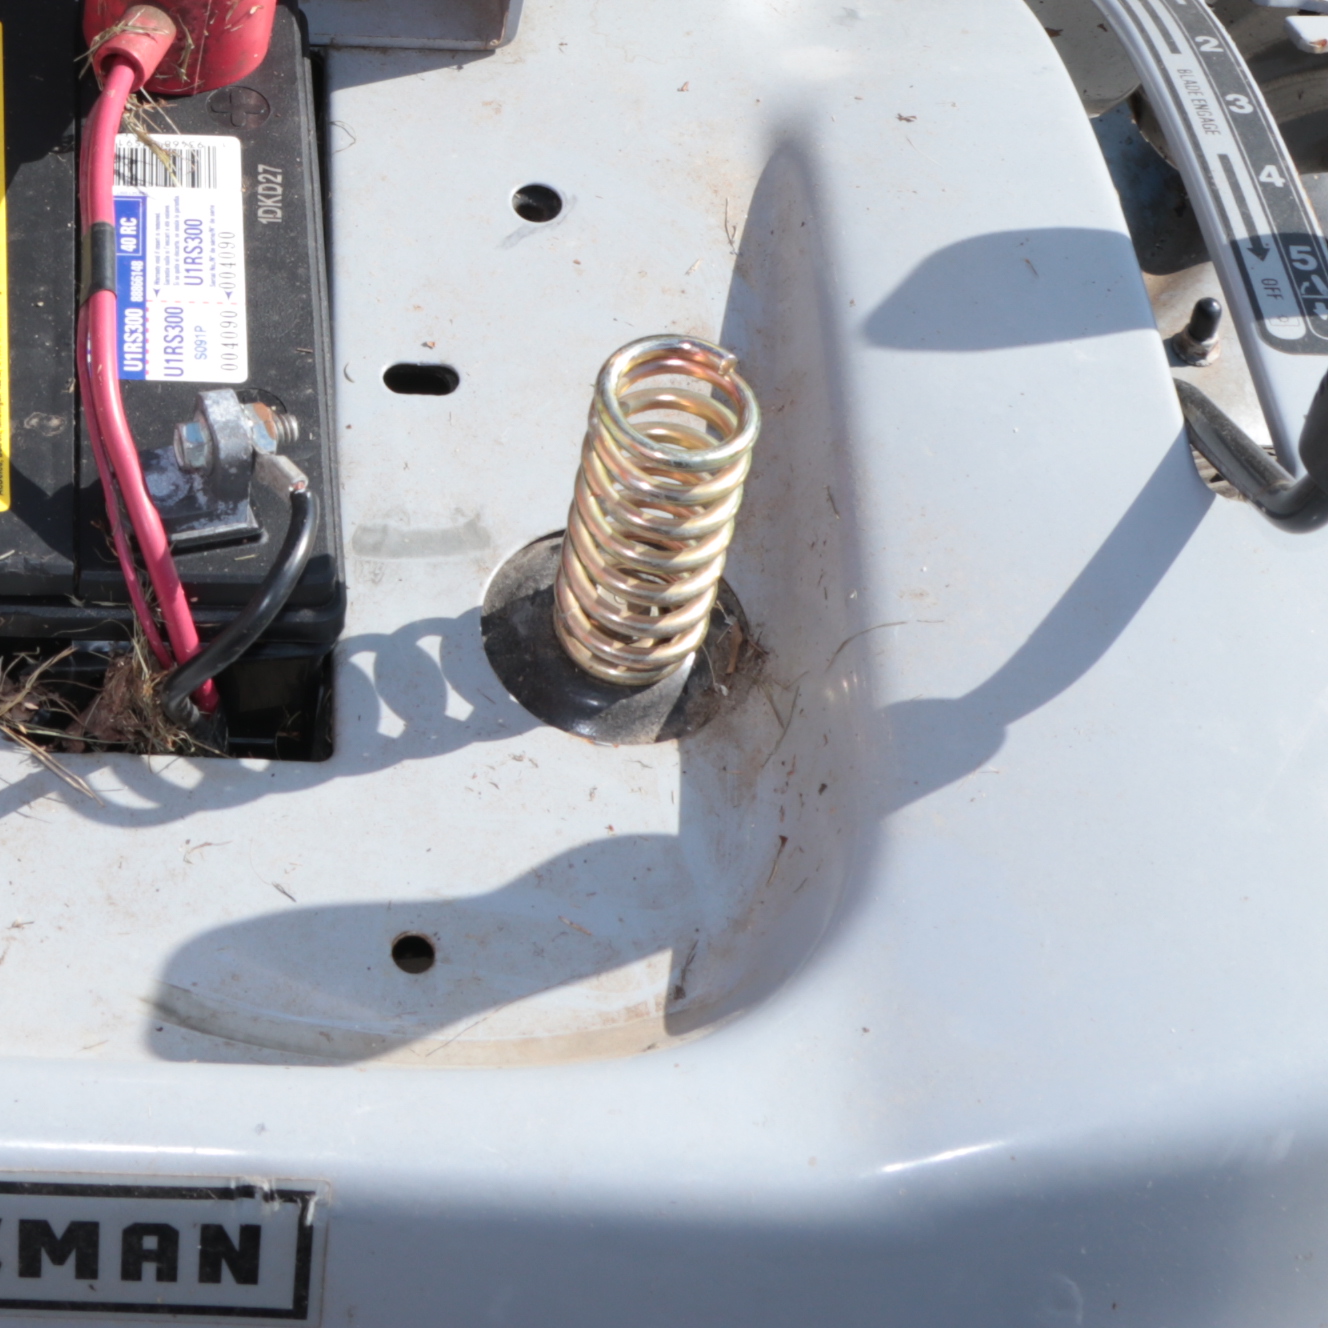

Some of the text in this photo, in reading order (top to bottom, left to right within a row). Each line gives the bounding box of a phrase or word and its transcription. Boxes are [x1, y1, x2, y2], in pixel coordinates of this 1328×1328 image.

[1195, 36, 1224, 52] 2
[1177, 69, 1221, 135] BLADE ENGAGE
[1224, 93, 1254, 114] 3
[257, 164, 282, 224] 1DKD27
[1259, 165, 1285, 187] 4
[120, 217, 137, 252] 40 RC
[183, 218, 203, 286] U1RS300
[218, 231, 236, 290] 004090
[1289, 245, 1318, 271] 5
[123, 260, 144, 371] U1RS300 88866148
[1261, 278, 1284, 299] OFF
[163, 306, 183, 377] U1RS300
[220, 310, 238, 371] 004090
